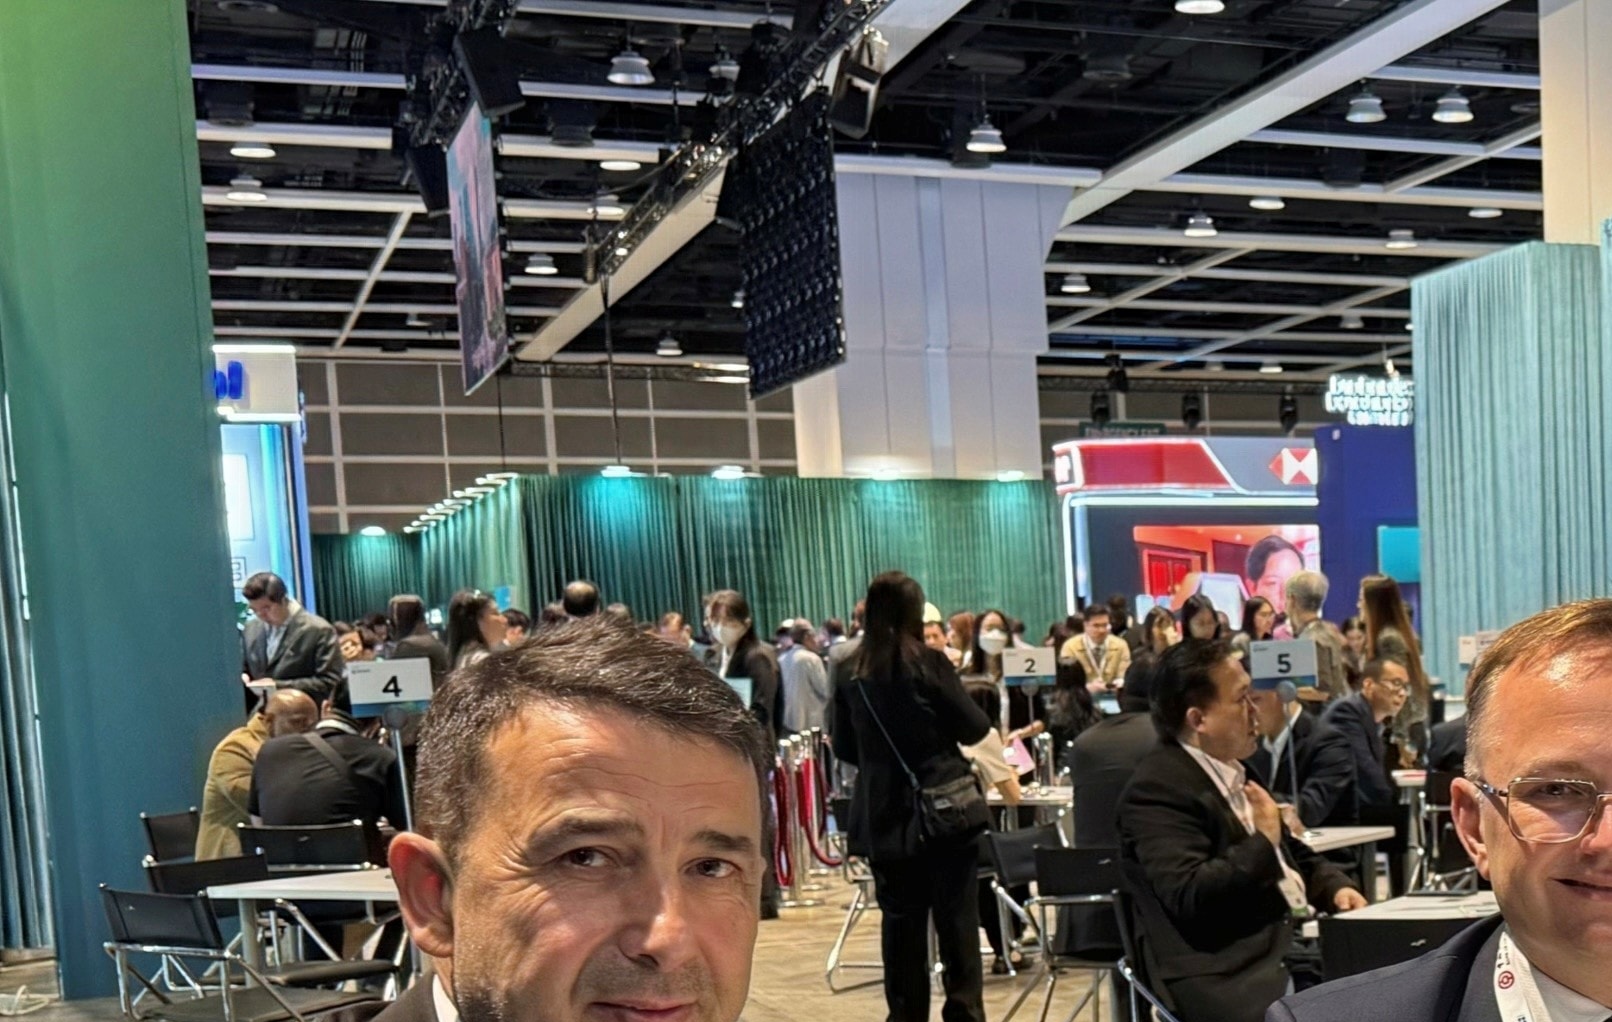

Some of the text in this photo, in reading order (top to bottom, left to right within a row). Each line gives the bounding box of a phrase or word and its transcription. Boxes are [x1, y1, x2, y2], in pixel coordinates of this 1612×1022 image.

[1024, 658, 1036, 673] 2
[1277, 653, 1292, 674] 5
[382, 675, 403, 697] 4
